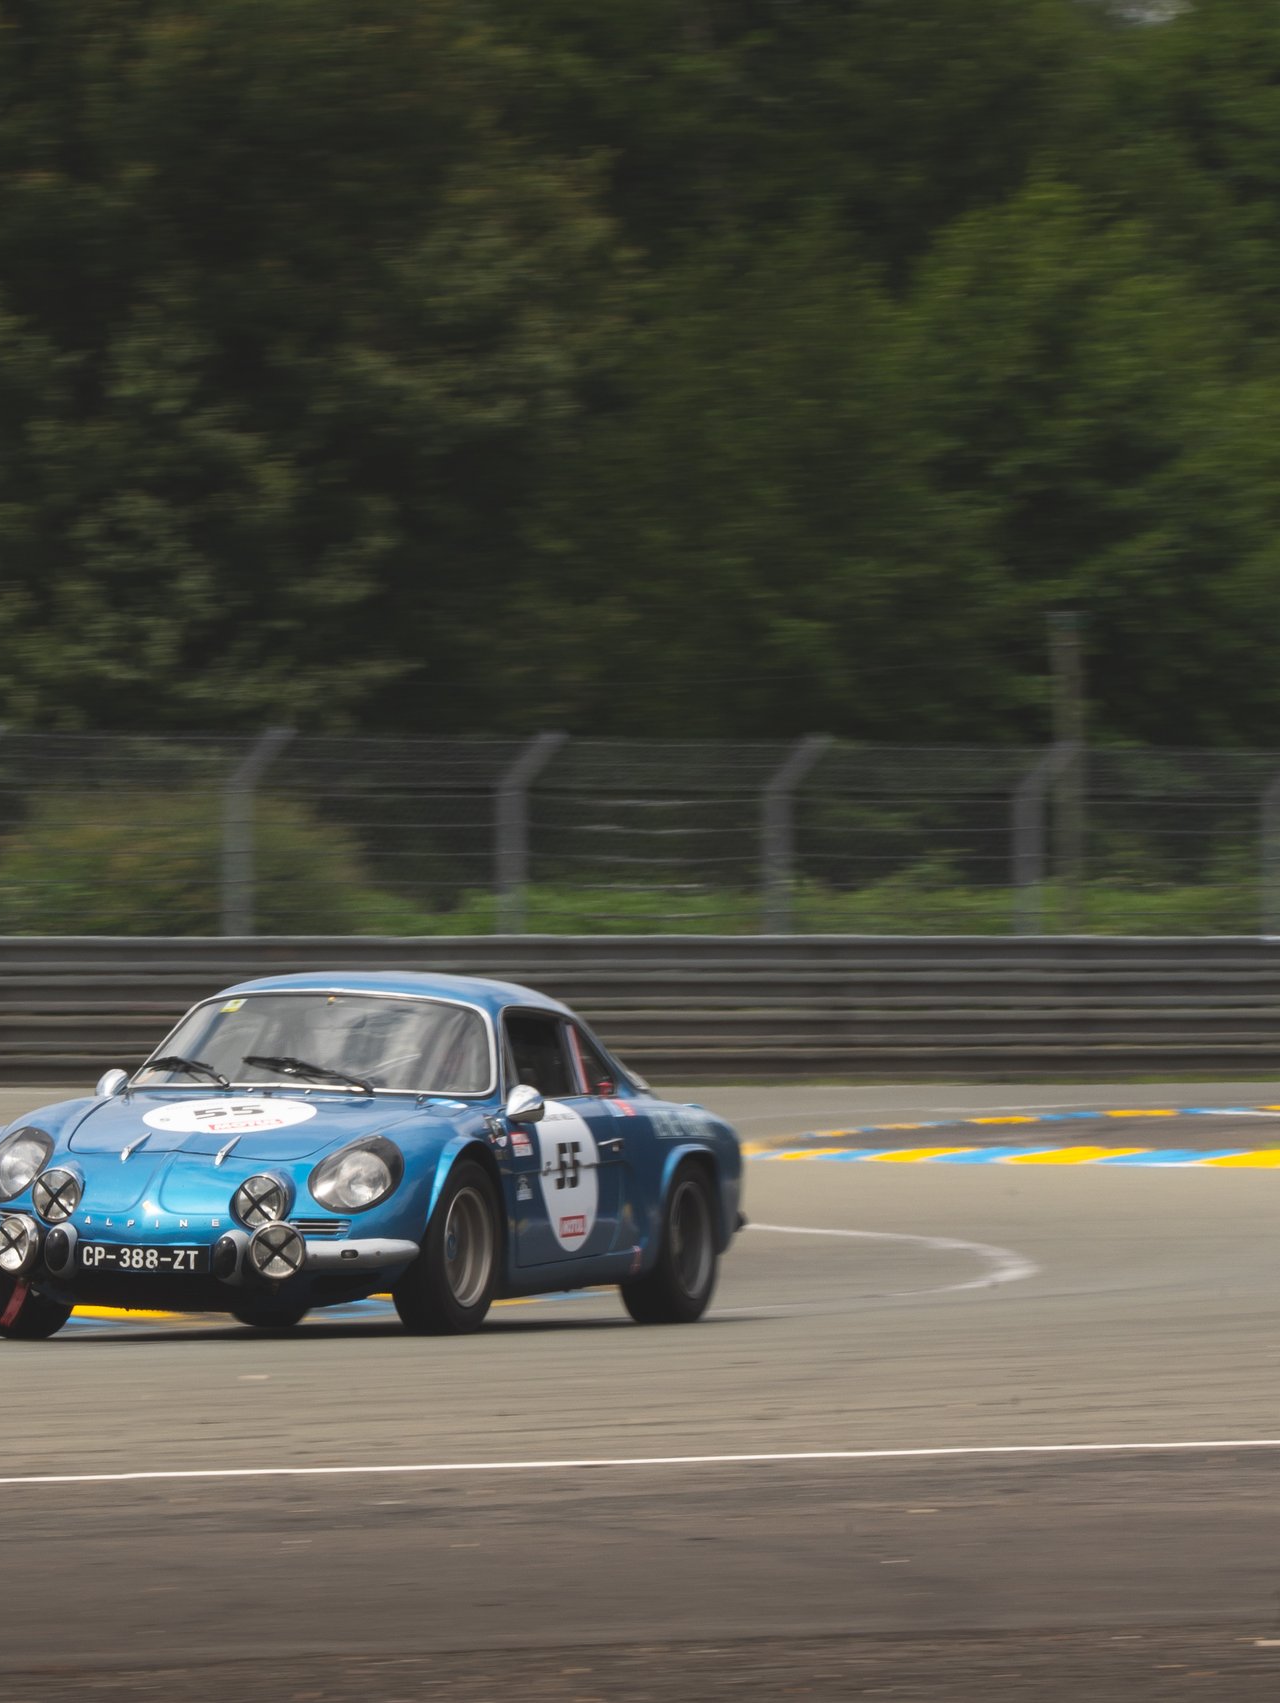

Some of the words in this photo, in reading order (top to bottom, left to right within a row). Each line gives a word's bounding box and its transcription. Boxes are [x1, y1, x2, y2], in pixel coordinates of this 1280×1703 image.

[193, 1104, 265, 1120] 55
[555, 1141, 581, 1190] 55
[84, 1215, 220, 1228] ALPINE
[82, 1246, 199, 1270] CP-388-ZT
